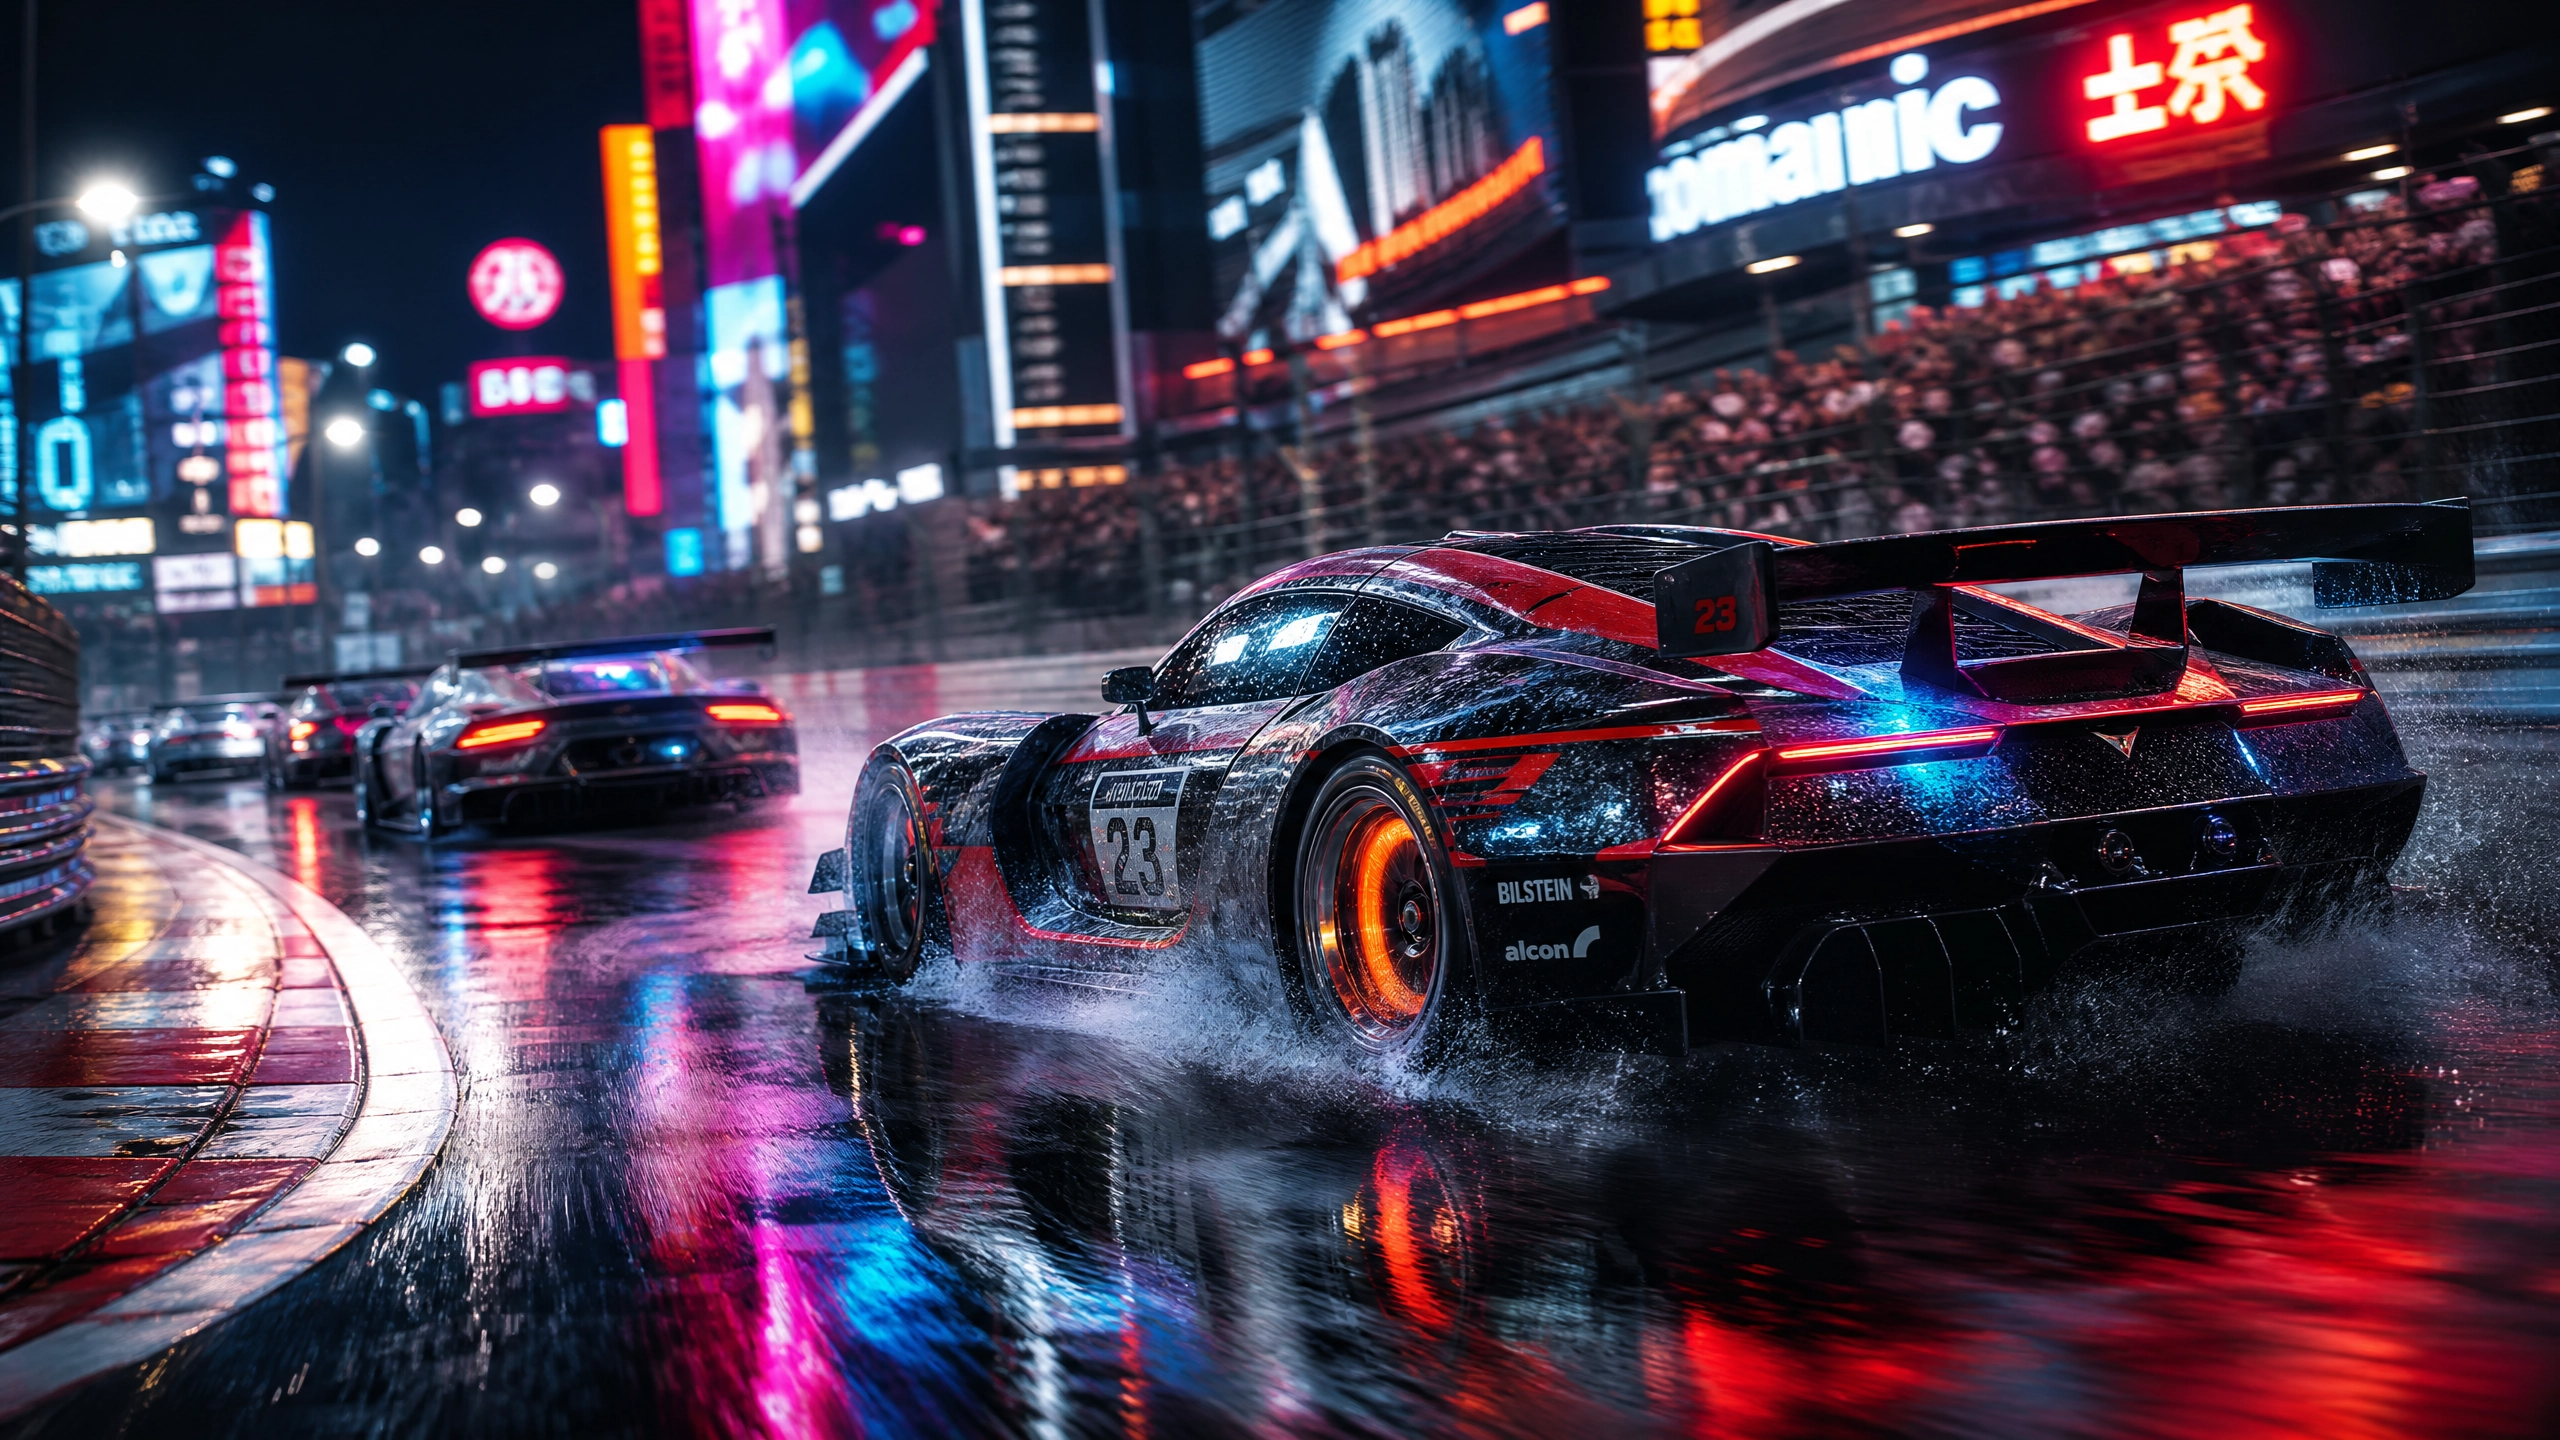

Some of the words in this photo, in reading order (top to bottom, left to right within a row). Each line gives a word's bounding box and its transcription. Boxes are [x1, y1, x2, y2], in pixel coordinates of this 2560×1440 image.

[1694, 595, 1737, 634] 23
[1107, 816, 1164, 896] 23
[1497, 877, 1573, 904] BILSTEIN
[1505, 940, 1570, 961] alcon
